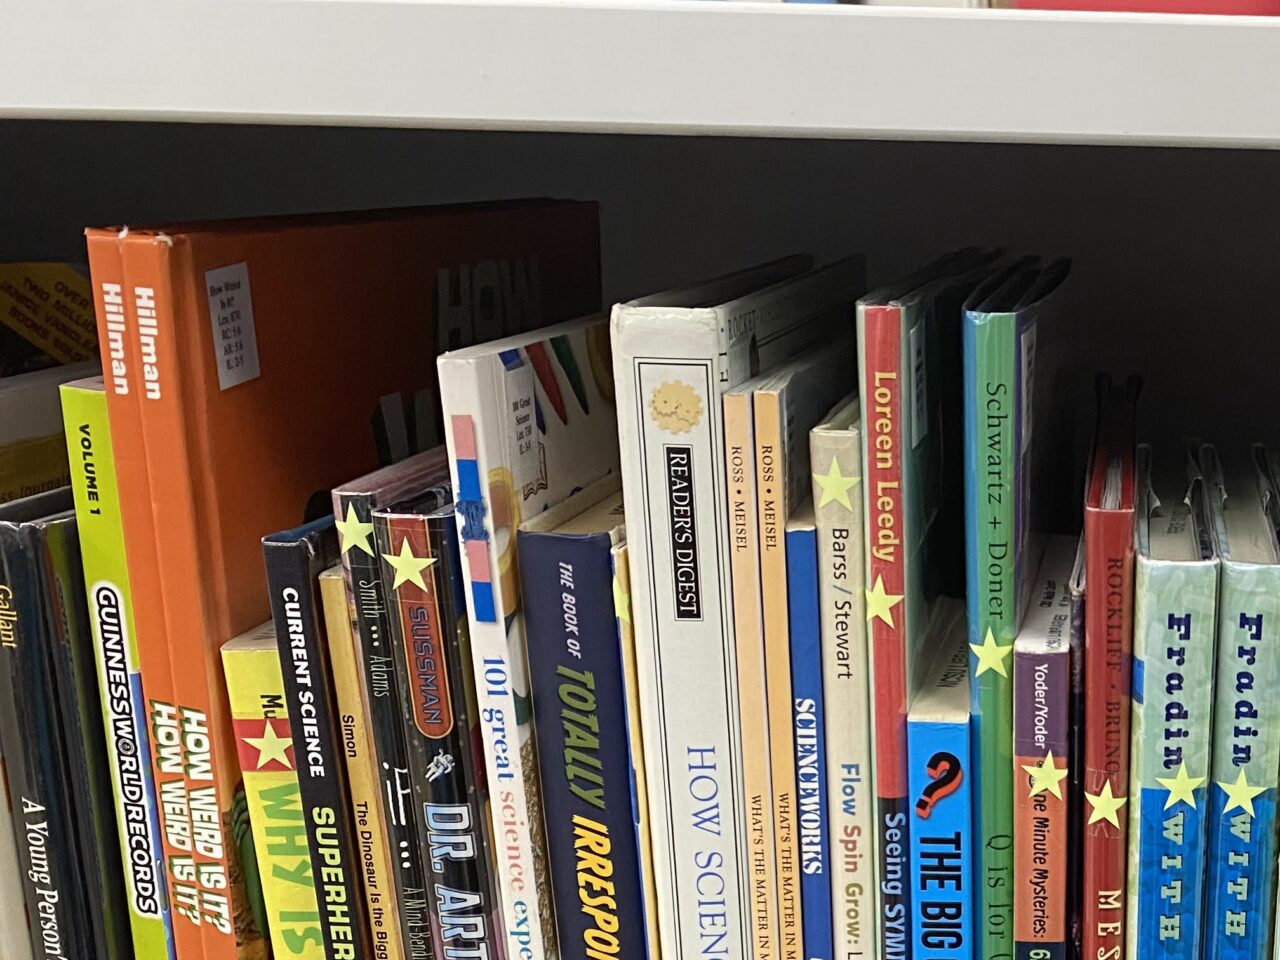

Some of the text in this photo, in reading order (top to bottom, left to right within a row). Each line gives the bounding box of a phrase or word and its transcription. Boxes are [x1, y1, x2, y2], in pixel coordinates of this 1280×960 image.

[102, 282, 129, 395] Hillman
[134, 287, 161, 400] Hillman
[79, 424, 98, 502] VOLUME
[873, 371, 899, 564] Loreen Leedy
[985, 382, 1008, 620] Schwartz Doner
[670, 452, 697, 614] READER'S DIGEST
[559, 561, 582, 659] THE BOOK OF
[831, 527, 853, 680] Barss Stewart
[283, 588, 325, 778] CURRENT SCIENCE
[408, 606, 443, 726] SUSSMAN
[482, 655, 509, 697] 101
[1034, 663, 1049, 750] Yoder/Yoder
[1162, 613, 1192, 769] Fradin
[1232, 613, 1264, 767] Fradin
[342, 714, 357, 758] Simon
[482, 708, 514, 783] great
[556, 665, 606, 810] TOTALLY
[21, 797, 45, 817] A
[179, 707, 232, 935] HOW WEIRD IS IT?
[355, 801, 368, 826] The
[686, 745, 721, 836] HOW
[795, 698, 823, 875] SCIENCEWORKS
[839, 763, 860, 817] Flow
[26, 815, 50, 884] Young
[258, 782, 314, 889] WHY
[360, 829, 377, 889] Dinosaur
[424, 802, 474, 873] DR.
[498, 789, 526, 892] science
[839, 824, 862, 874] Spin
[881, 813, 906, 896] Seeing
[918, 831, 962, 892] THE
[279, 910, 322, 955] IS
[372, 906, 383, 929] the
[844, 882, 863, 944] Grow:
[920, 900, 963, 949] BIG
